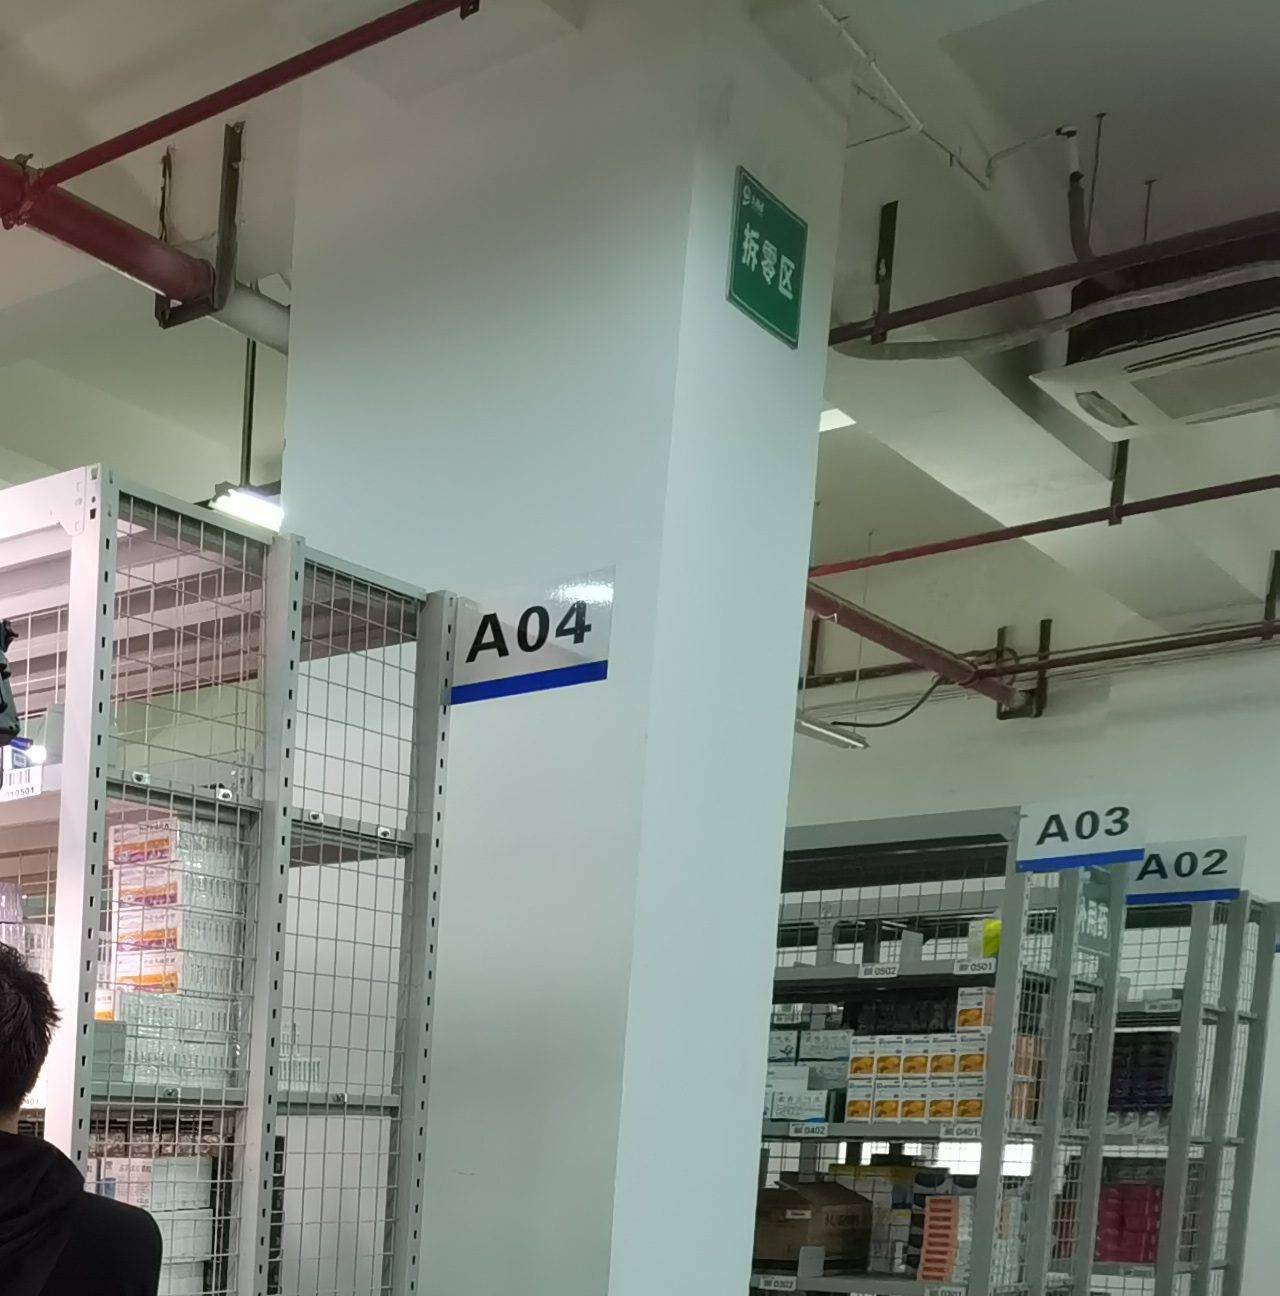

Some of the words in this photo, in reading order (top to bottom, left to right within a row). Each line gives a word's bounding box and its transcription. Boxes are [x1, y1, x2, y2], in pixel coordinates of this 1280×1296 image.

[742, 222, 796, 301] 拆零区
[465, 600, 592, 664] A04
[1035, 806, 1131, 846] A03
[1135, 848, 1230, 882] A02
